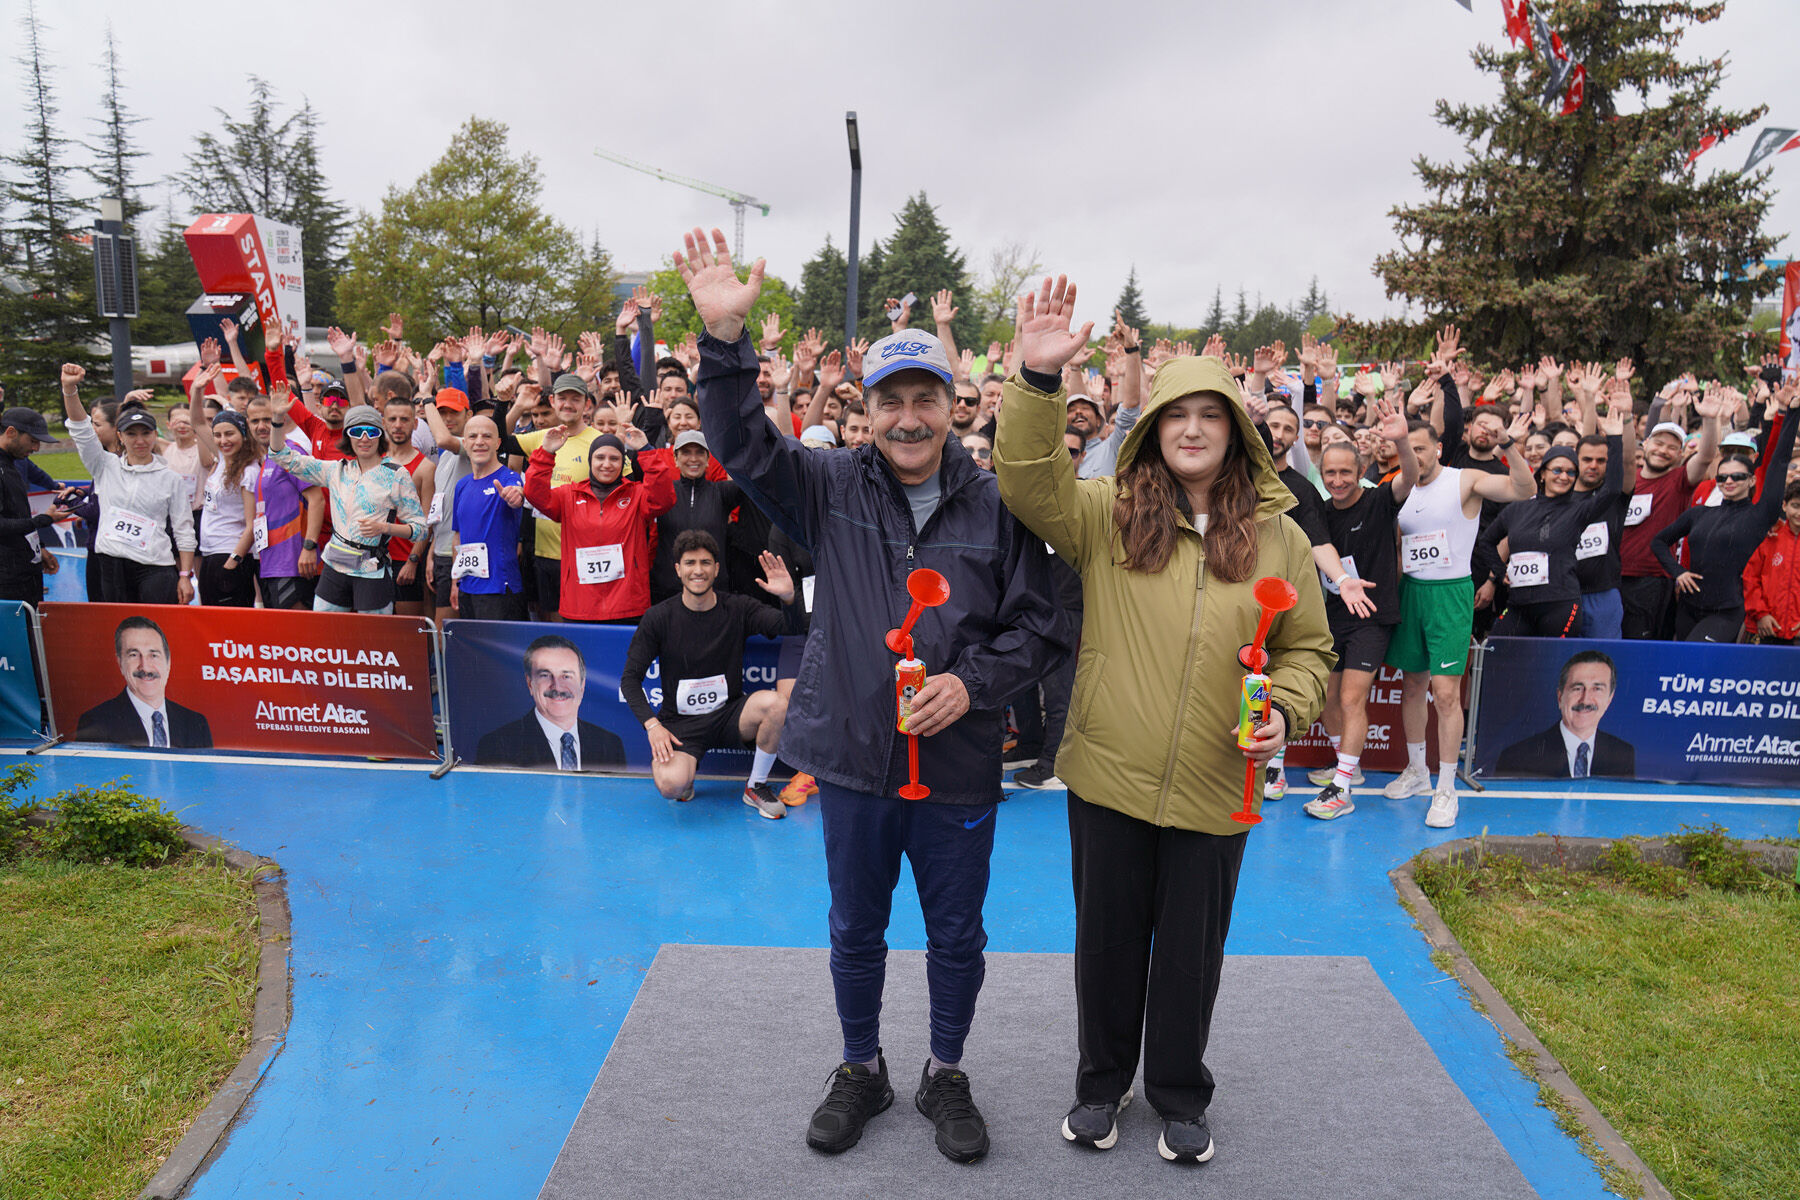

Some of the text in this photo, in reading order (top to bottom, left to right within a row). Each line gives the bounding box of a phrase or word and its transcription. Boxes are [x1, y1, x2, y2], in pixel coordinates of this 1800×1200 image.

[115, 520, 143, 537] 813
[458, 555, 479, 567] 988
[1410, 546, 1440, 561] 360
[587, 561, 611, 574] 317
[1513, 563, 1539, 577] 708
[209, 639, 400, 667] TÜM SPORCULARA
[201, 665, 413, 691] BAŞARILAR DİLERİM.
[1659, 673, 1705, 693] TÜM
[686, 691, 718, 707] 669
[1249, 686, 1269, 702] Air
[255, 700, 368, 726] Ahmet Ataç
[1642, 697, 1764, 718] BAŞARILAR
[1687, 732, 1800, 757] Ahmet Ataç
